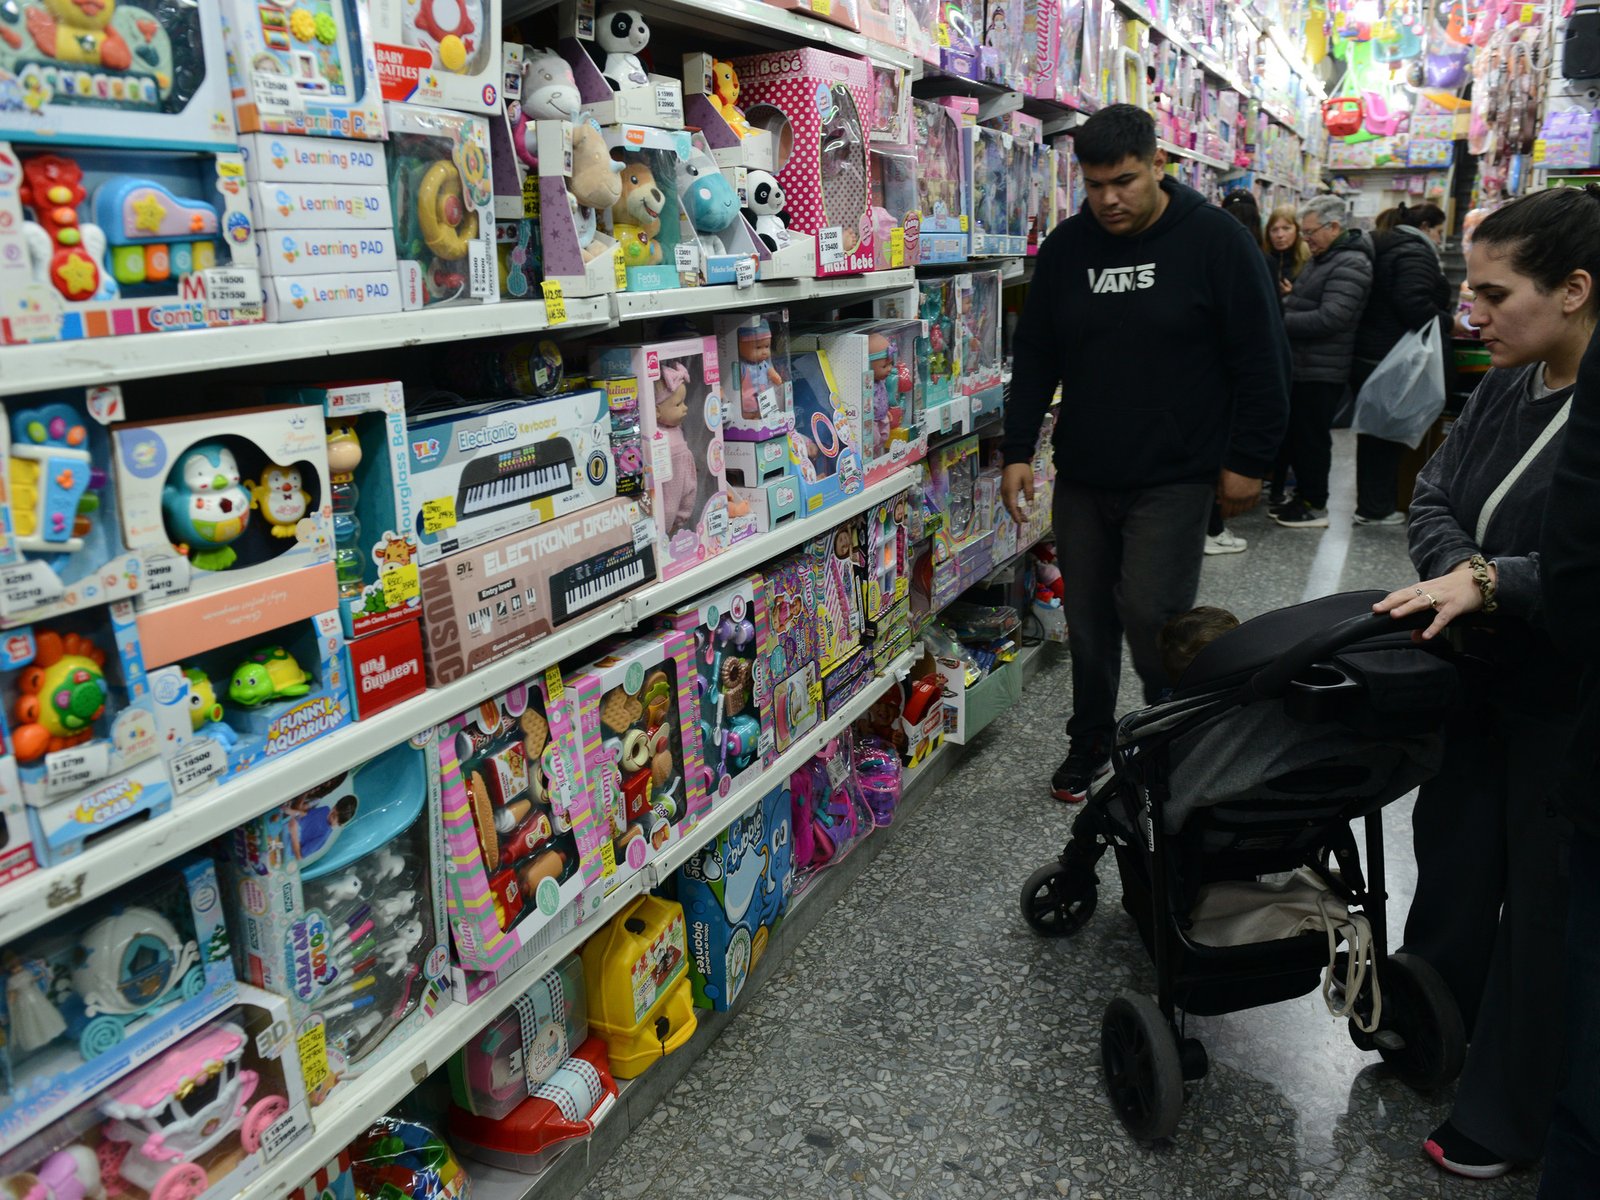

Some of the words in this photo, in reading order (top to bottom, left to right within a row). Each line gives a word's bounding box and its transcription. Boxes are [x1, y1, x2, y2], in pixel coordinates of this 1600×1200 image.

[377, 50, 404, 66] BABY
[377, 62, 417, 79] RATTLES
[759, 55, 801, 76] Bebé
[294, 148, 348, 169] Learning
[350, 152, 375, 167] PAD
[299, 195, 352, 215] Learning
[304, 240, 358, 259] Learning
[360, 240, 383, 254] PAD
[850, 252, 873, 271] Bebé
[312, 284, 364, 303] Learning
[366, 284, 389, 298] PAD
[1087, 263, 1156, 293] VANS
[457, 422, 518, 451] Electronic
[518, 417, 557, 434] Keyboard
[483, 525, 581, 577] ELECTRONIC
[581, 503, 629, 541] ORGAN
[455, 561, 474, 577] SYL
[481, 583, 499, 598] Entry
[498, 580, 513, 593] level
[420, 562, 465, 685] MUSIC
[360, 655, 386, 676] Fun
[362, 659, 418, 693] Learning
[279, 698, 326, 733] FUNNY
[265, 710, 342, 755] AQUARIUM
[81, 778, 131, 811] FUNNY
[592, 749, 615, 817] Juliana
[93, 797, 131, 824] CRAB
[730, 813, 762, 865] bubble
[291, 920, 308, 950] MY
[309, 920, 328, 977] COLOR
[460, 915, 483, 966] Juliana
[692, 921, 705, 974] gigantes
[295, 951, 313, 998] PETS
[256, 1019, 289, 1056] 3D
